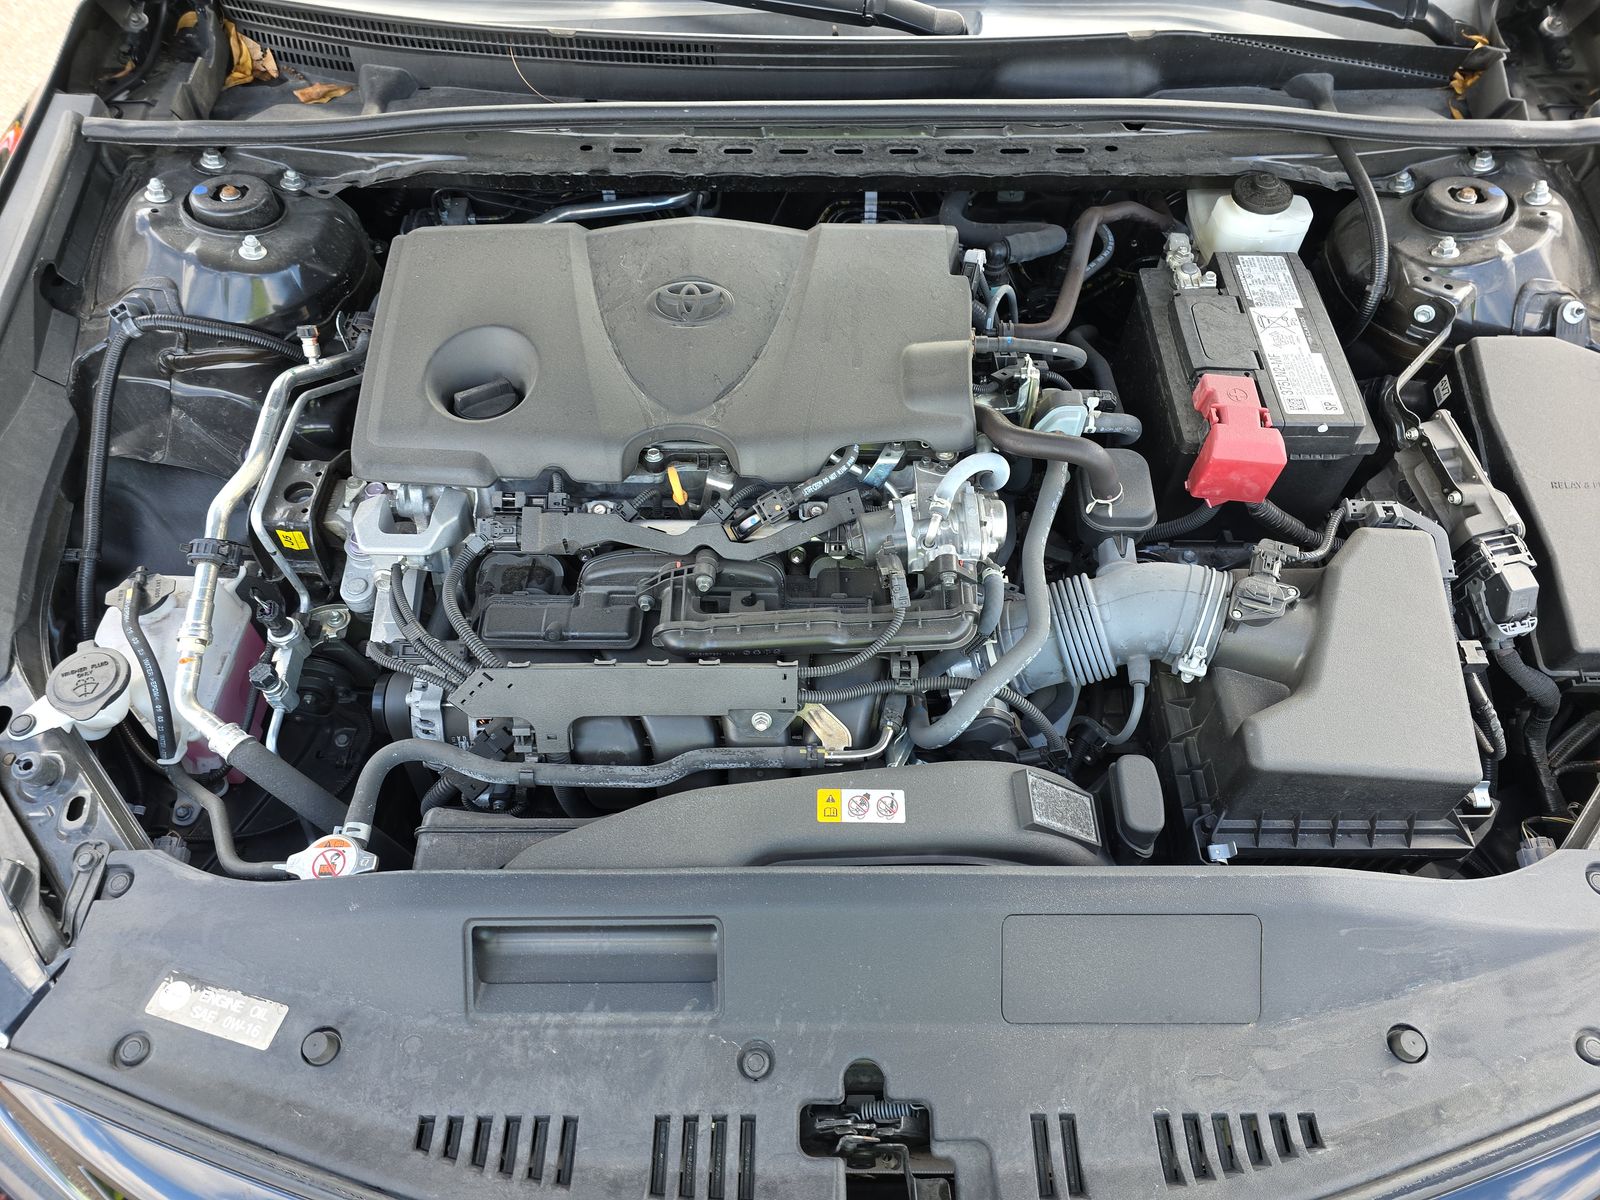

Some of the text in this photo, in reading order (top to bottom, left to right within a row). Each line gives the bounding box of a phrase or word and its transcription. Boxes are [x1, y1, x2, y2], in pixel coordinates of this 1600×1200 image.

[1323, 401, 1338, 411] SP
[1550, 481, 1582, 489] RELAY
[143, 657, 154, 679] WATER
[200, 989, 269, 1022] ENGINE OIL
[191, 1005, 262, 1038] SAE 0W-16
